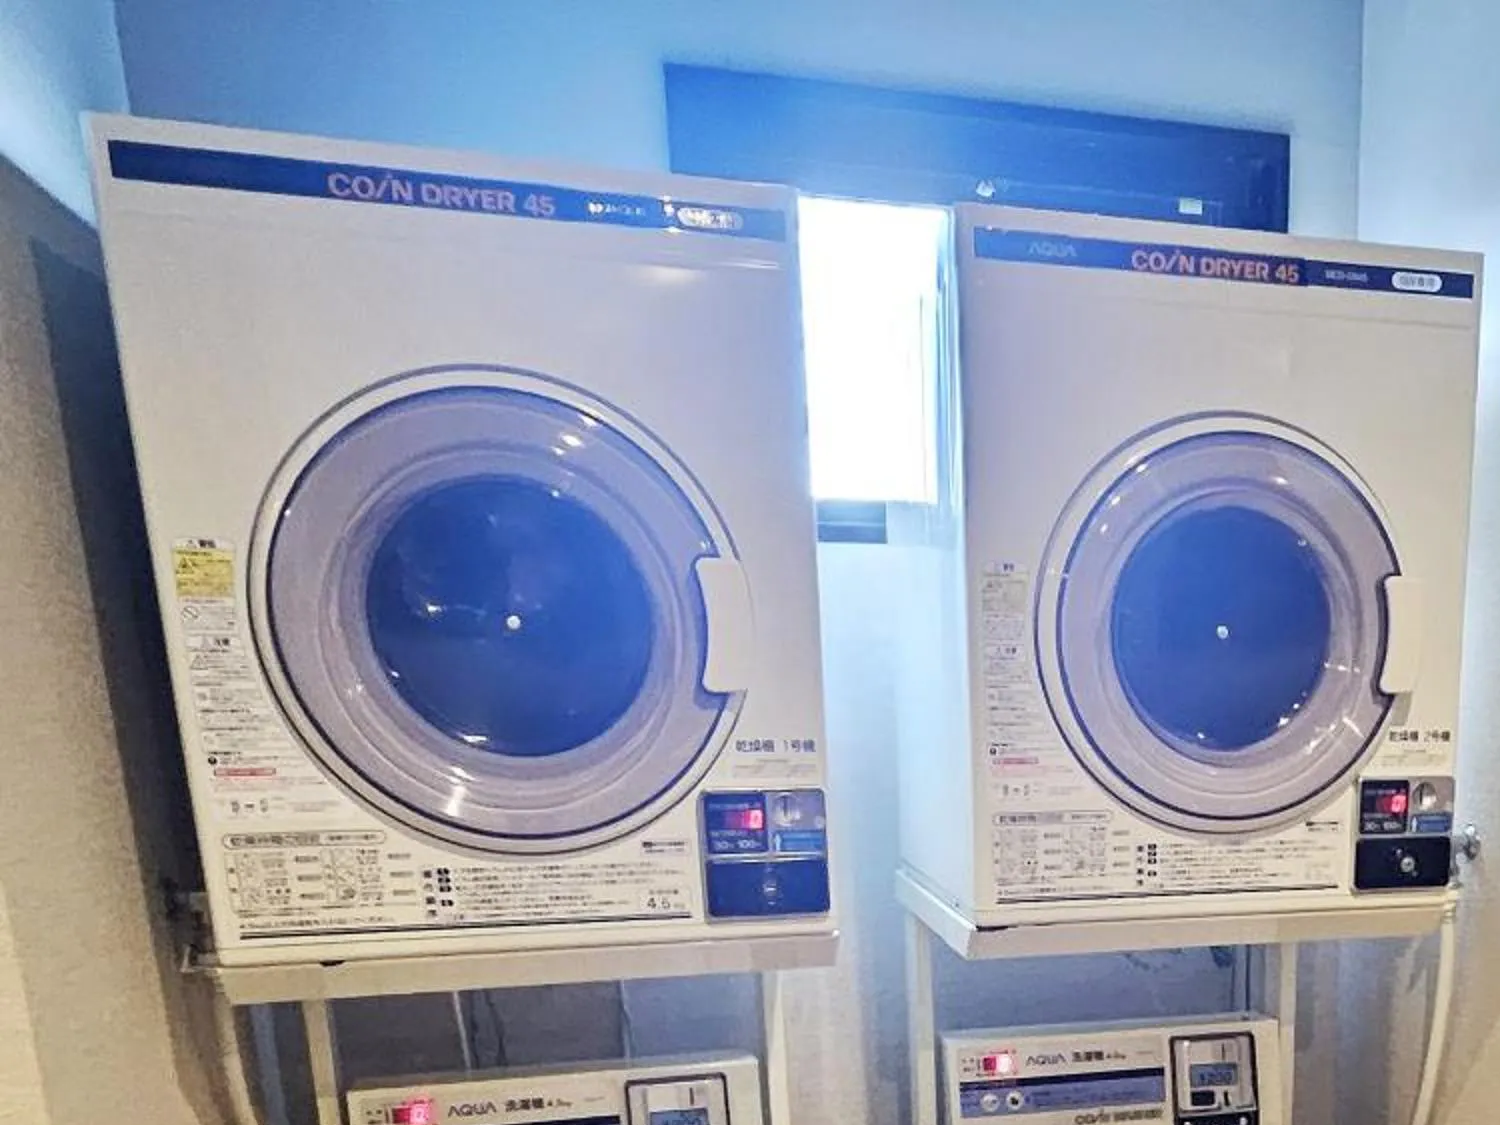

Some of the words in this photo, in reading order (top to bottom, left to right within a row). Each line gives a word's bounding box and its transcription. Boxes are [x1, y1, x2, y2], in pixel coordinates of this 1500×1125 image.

[421, 183, 515, 213] DRYER
[523, 193, 555, 217] 45
[1028, 241, 1078, 257] AQUA
[1201, 257, 1269, 280] DRYER
[1275, 264, 1299, 283] 45
[1026, 1053, 1069, 1066] AQUA
[448, 1101, 497, 1118] AQUA
